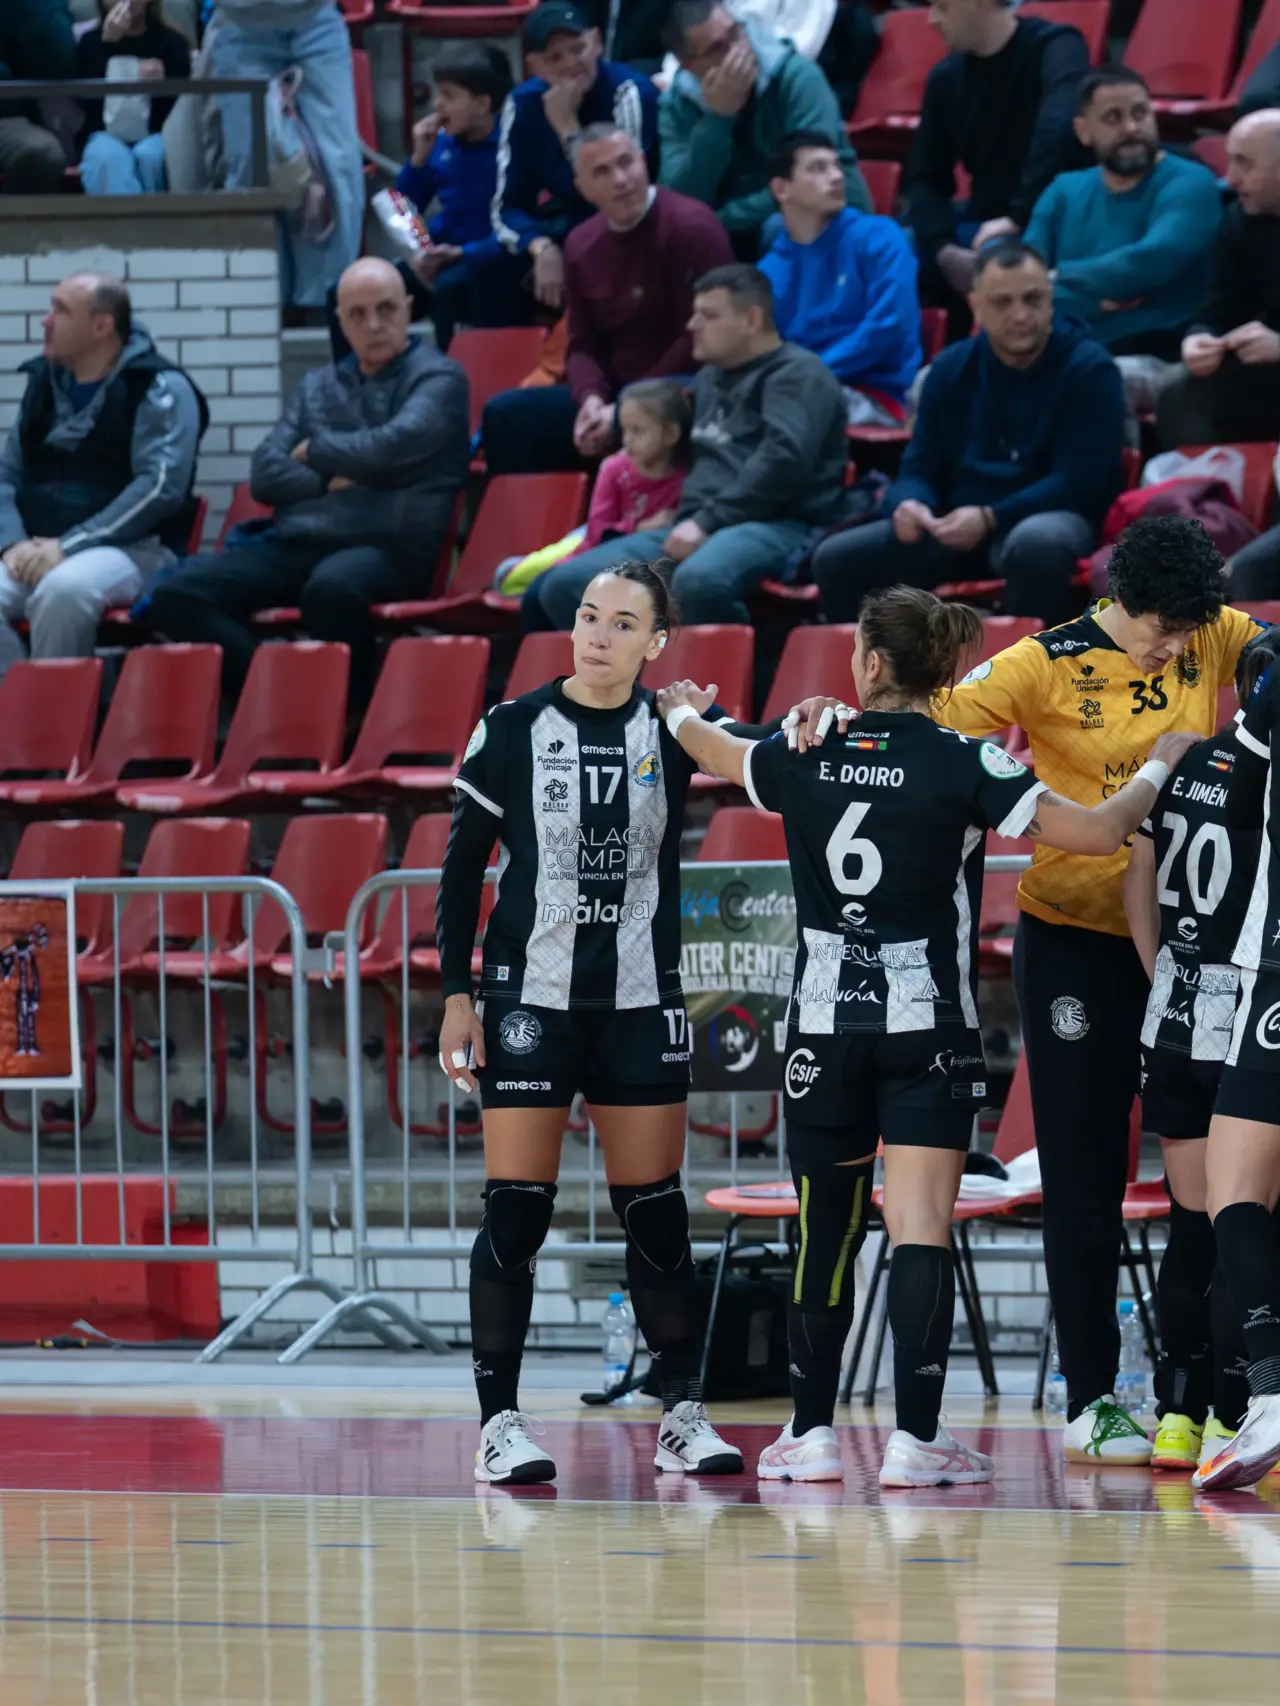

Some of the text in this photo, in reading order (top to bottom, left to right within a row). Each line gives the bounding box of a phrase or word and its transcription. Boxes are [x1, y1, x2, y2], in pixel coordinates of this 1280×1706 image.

[1071, 677, 1109, 686] Fundación
[1076, 684, 1104, 693] Unicaja
[1128, 674, 1168, 715] 38
[537, 756, 577, 765] Fundación
[543, 763, 572, 773] Unicaja
[584, 765, 623, 804] 17
[819, 761, 904, 787] E. DOIRO
[1172, 776, 1229, 808] E. JIMÉN
[545, 823, 656, 847] MÁLAGA
[825, 801, 883, 896] 6
[1157, 811, 1232, 915] 20
[560, 871, 610, 881] PROVINCIA
[611, 872, 624, 880] EN
[663, 1008, 686, 1045] 17
[790, 1062, 822, 1084] CSIF
